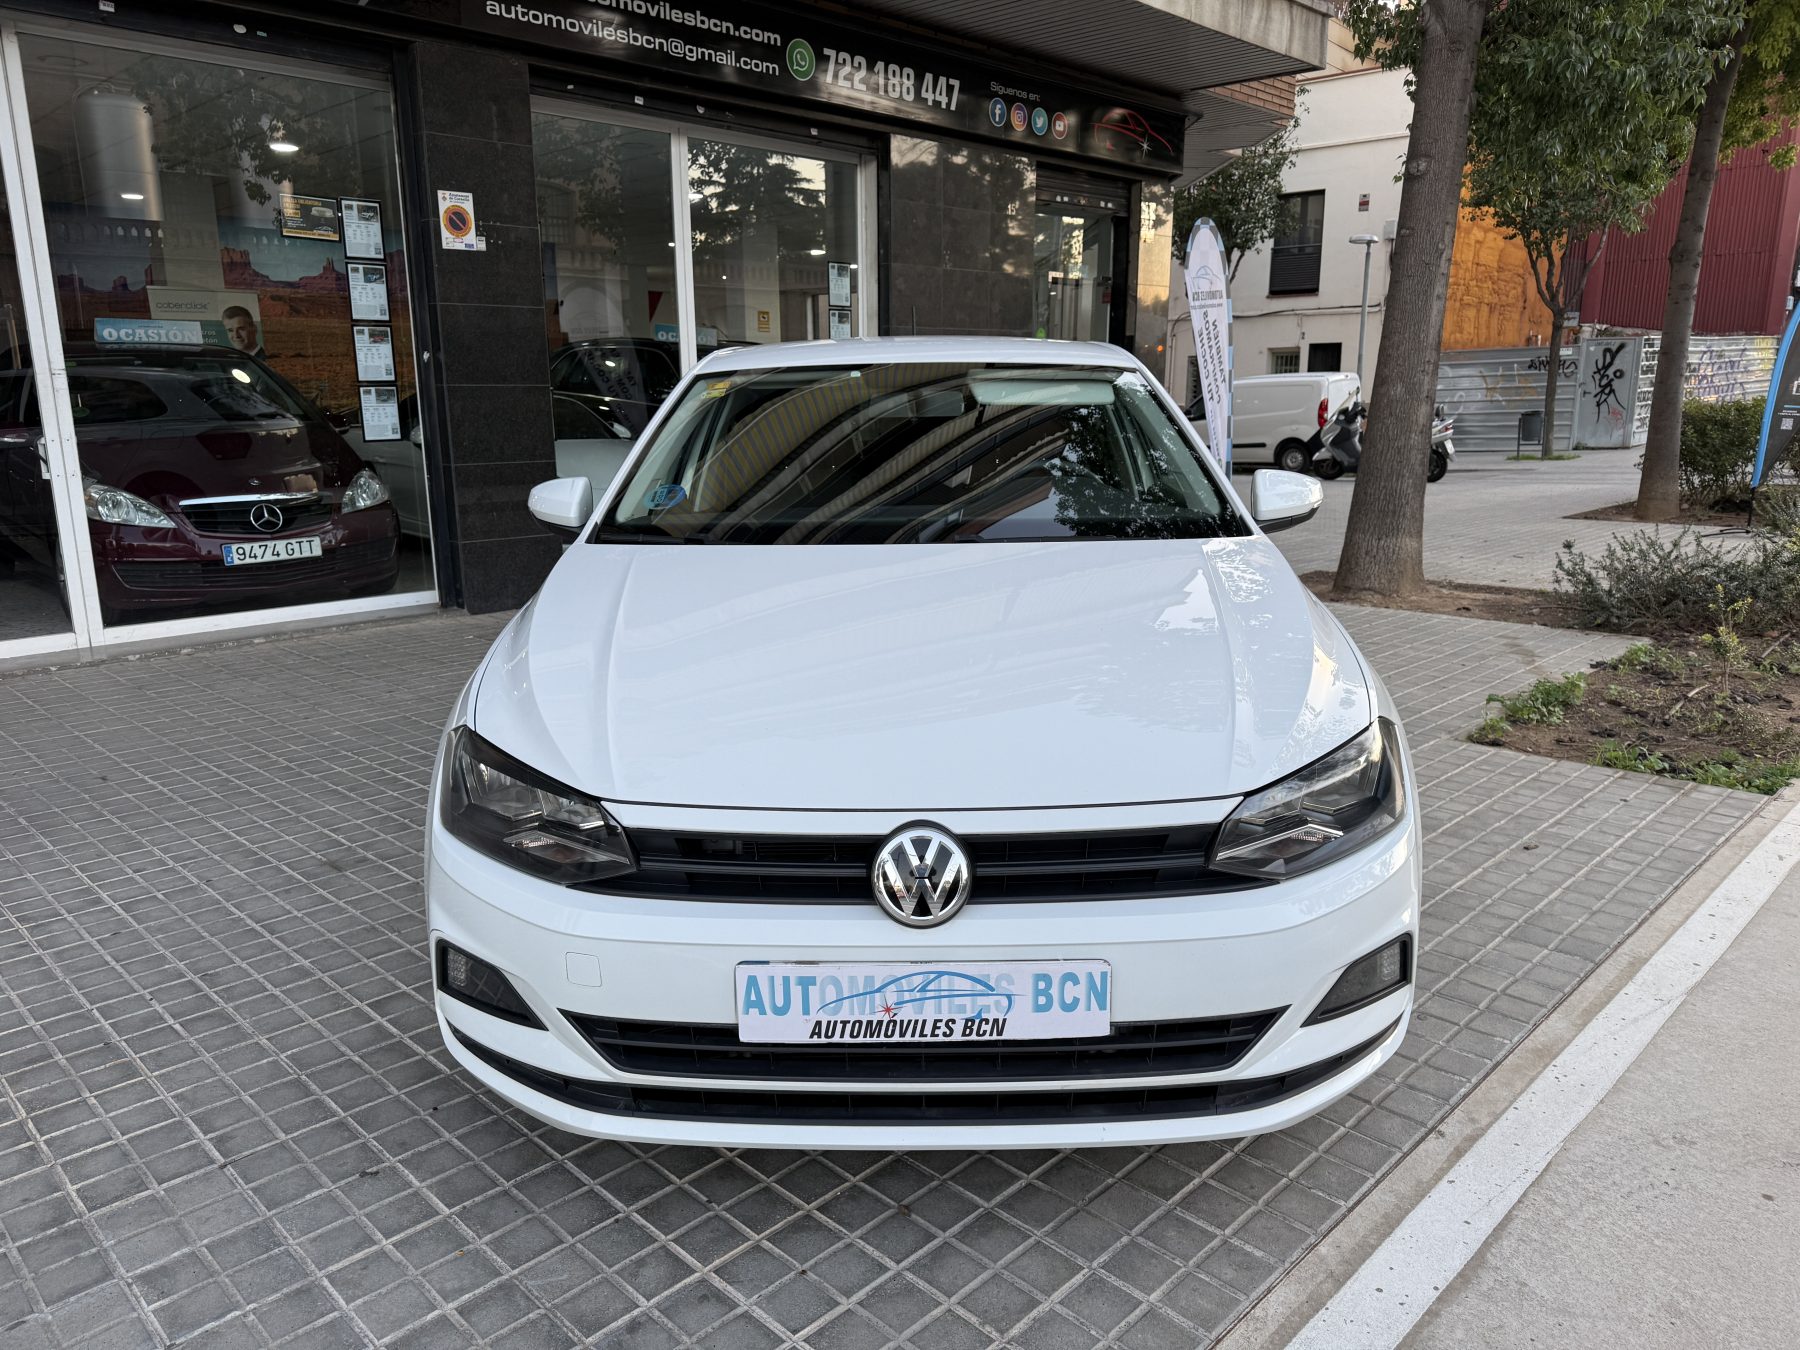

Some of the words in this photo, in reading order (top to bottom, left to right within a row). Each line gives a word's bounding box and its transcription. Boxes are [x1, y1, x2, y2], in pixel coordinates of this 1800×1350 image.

[486, 1, 780, 76] automovilesbcn@gmail.com
[823, 47, 867, 92] 722
[873, 60, 916, 102] 188
[920, 72, 961, 112] 447
[990, 81, 1028, 99] Síguenos
[102, 327, 203, 343] OCASIÓN
[236, 543, 281, 561] 9474
[285, 540, 314, 557] GTT
[1031, 970, 1109, 1013] BCN
[961, 1018, 1008, 1038] BCN
